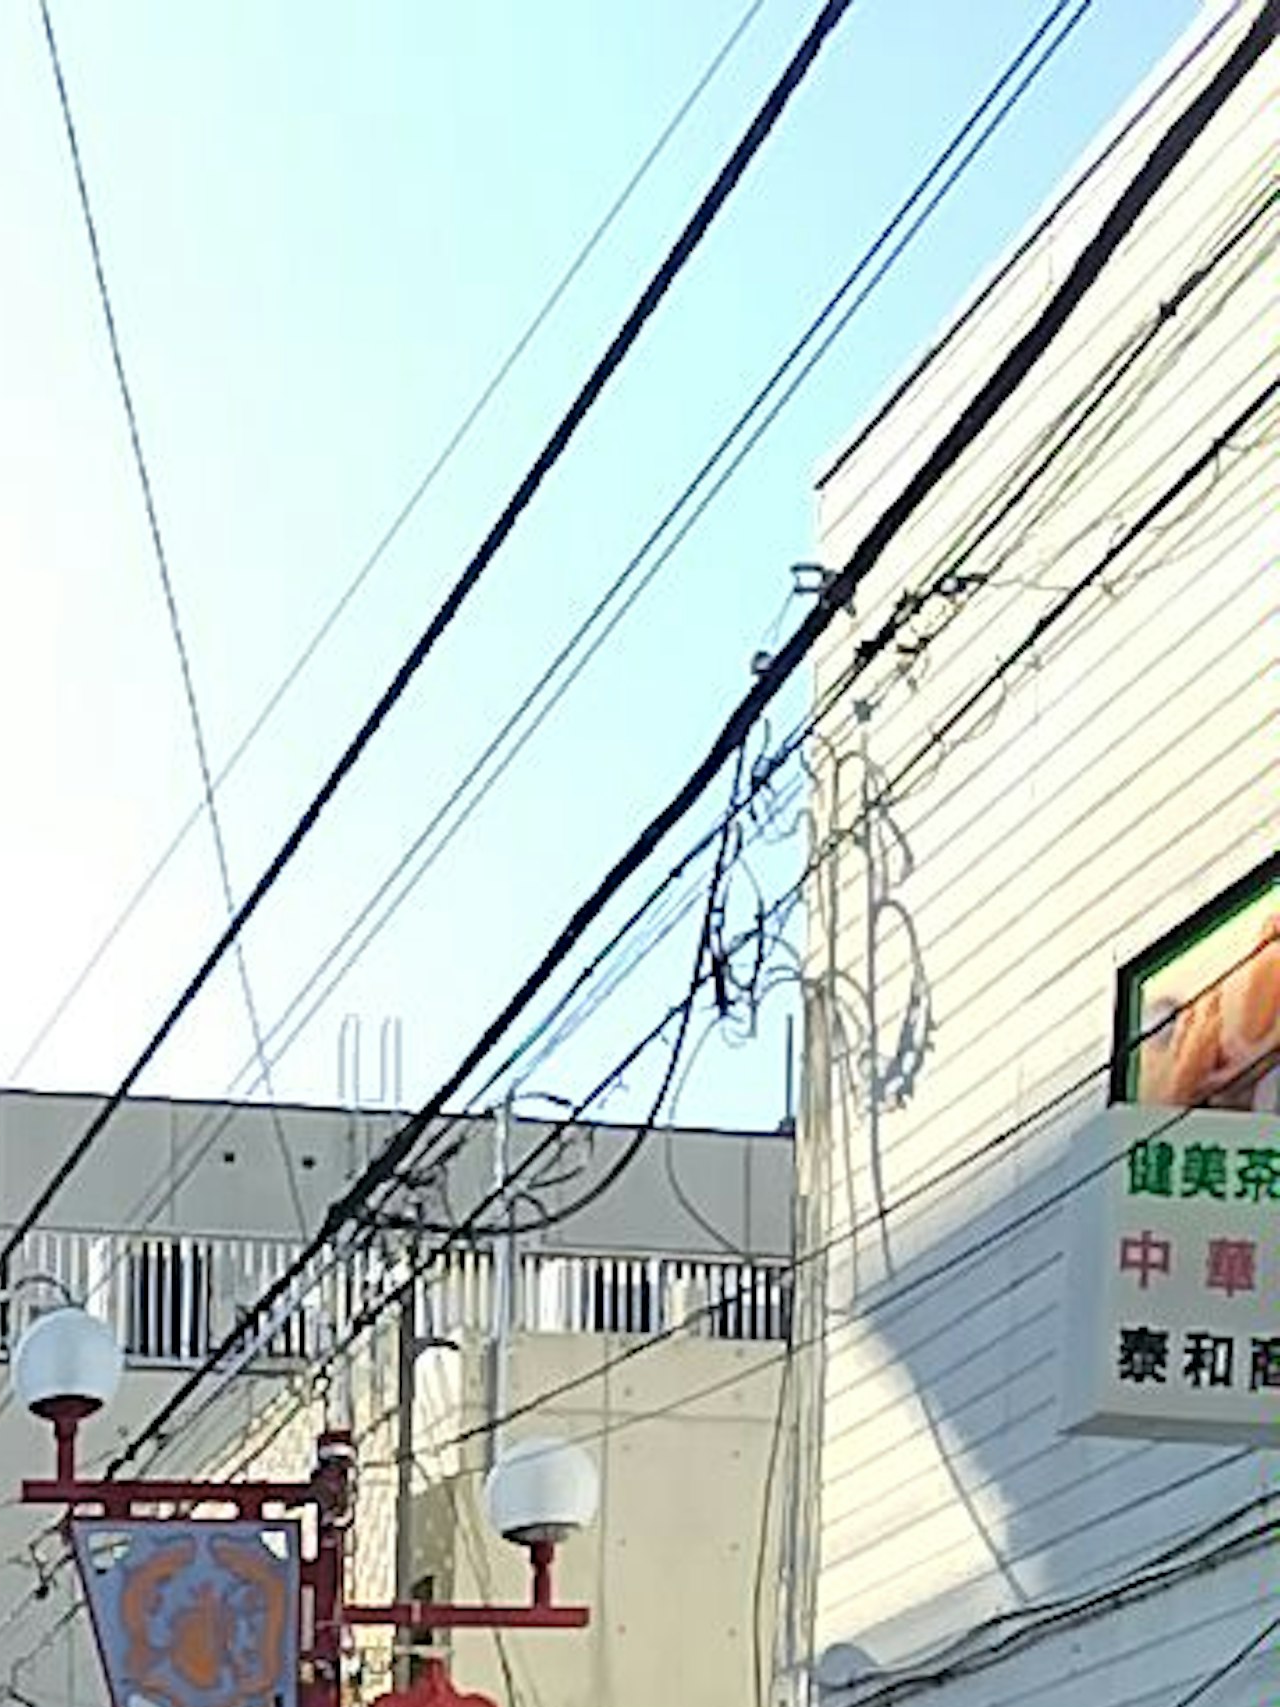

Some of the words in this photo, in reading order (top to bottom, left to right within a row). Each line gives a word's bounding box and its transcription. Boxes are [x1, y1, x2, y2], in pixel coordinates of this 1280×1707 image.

[1127, 1139, 1280, 1202] 健美茶
[1118, 1229, 1256, 1298] 中華
